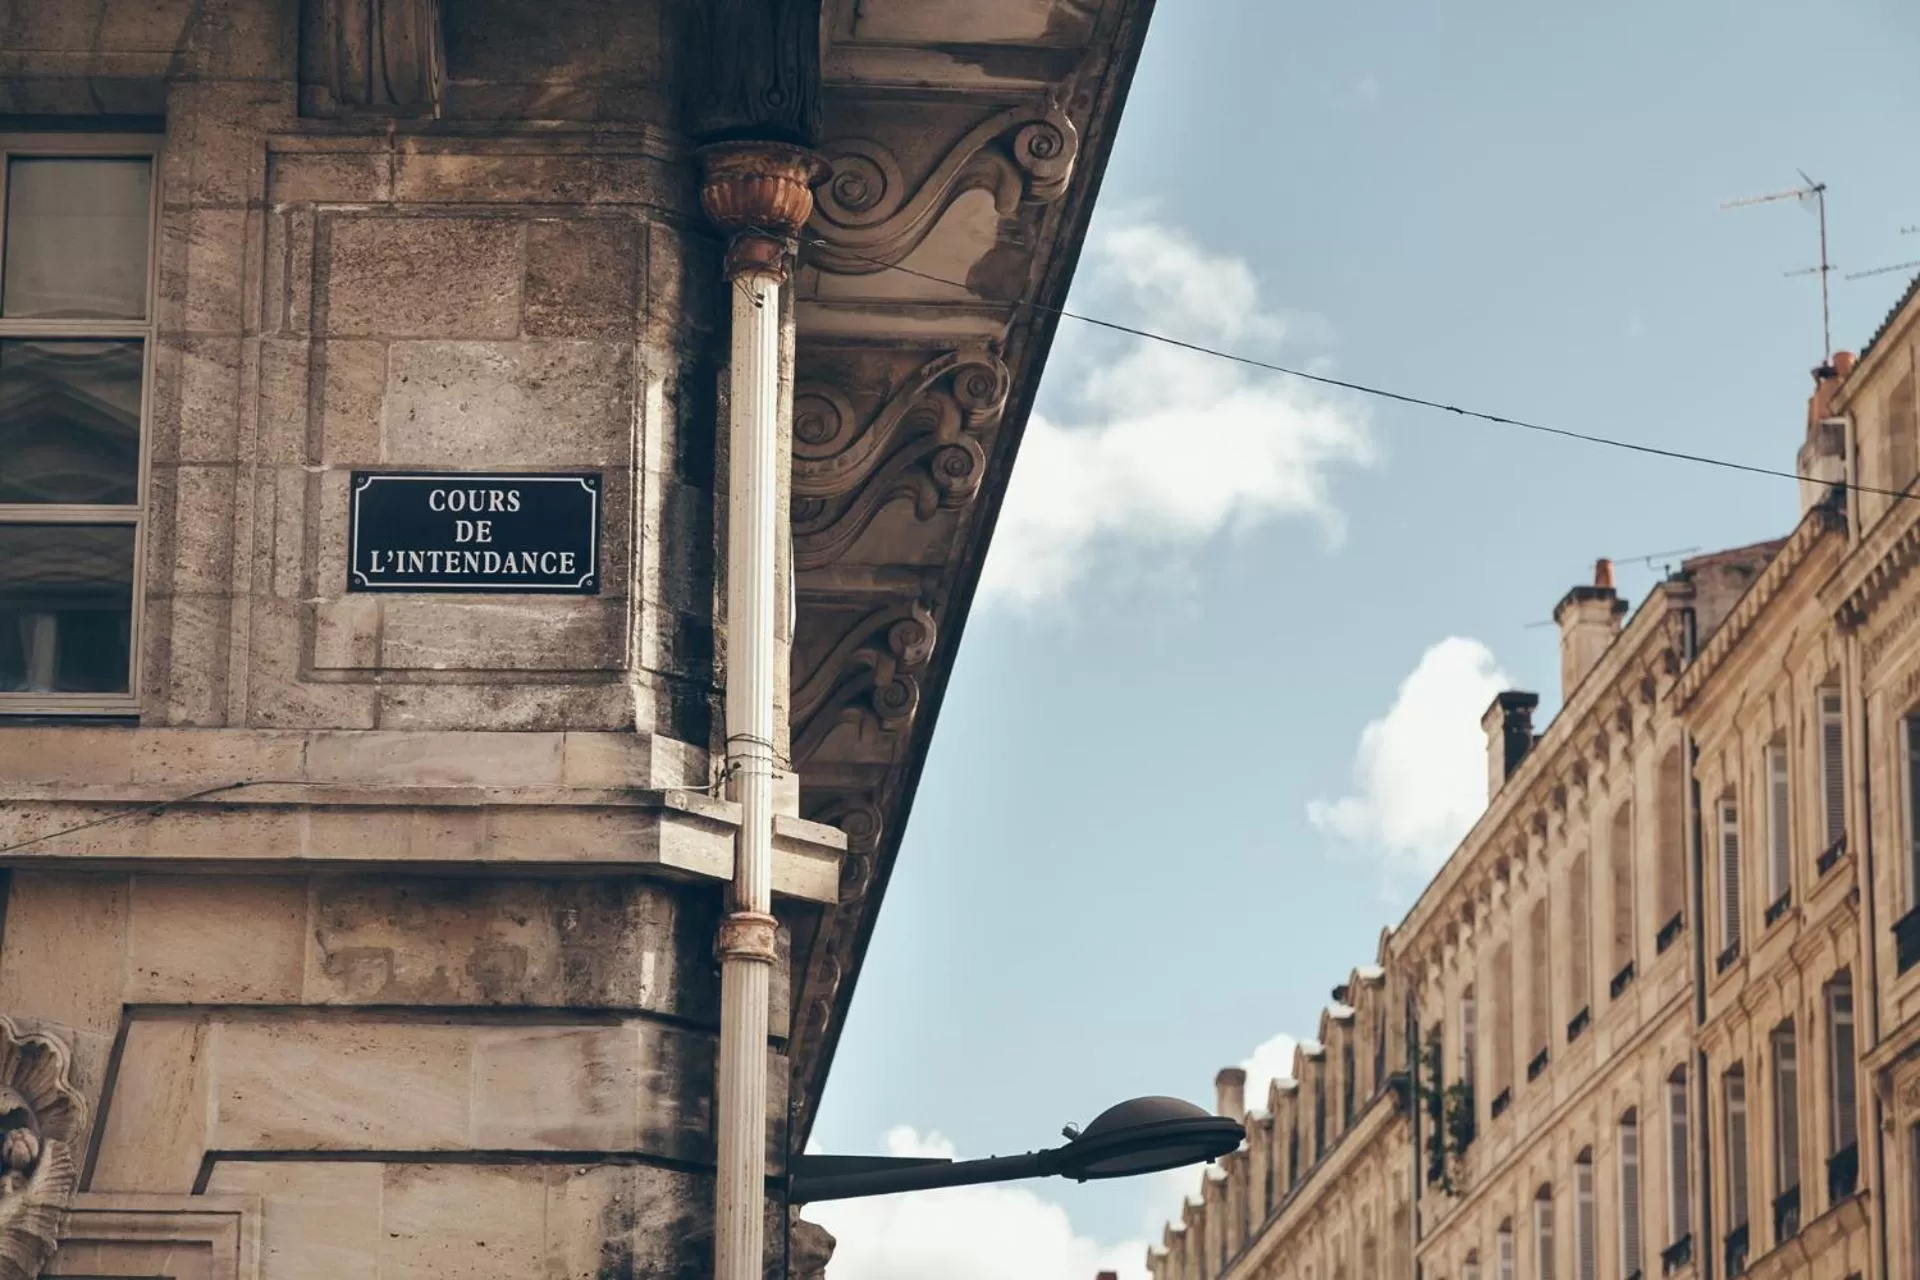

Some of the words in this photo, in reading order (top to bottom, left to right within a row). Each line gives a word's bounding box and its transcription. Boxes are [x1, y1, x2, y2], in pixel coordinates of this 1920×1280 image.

[429, 489, 521, 512] COURS
[455, 520, 492, 543] DE
[370, 550, 576, 574] L'INTENDANCE
